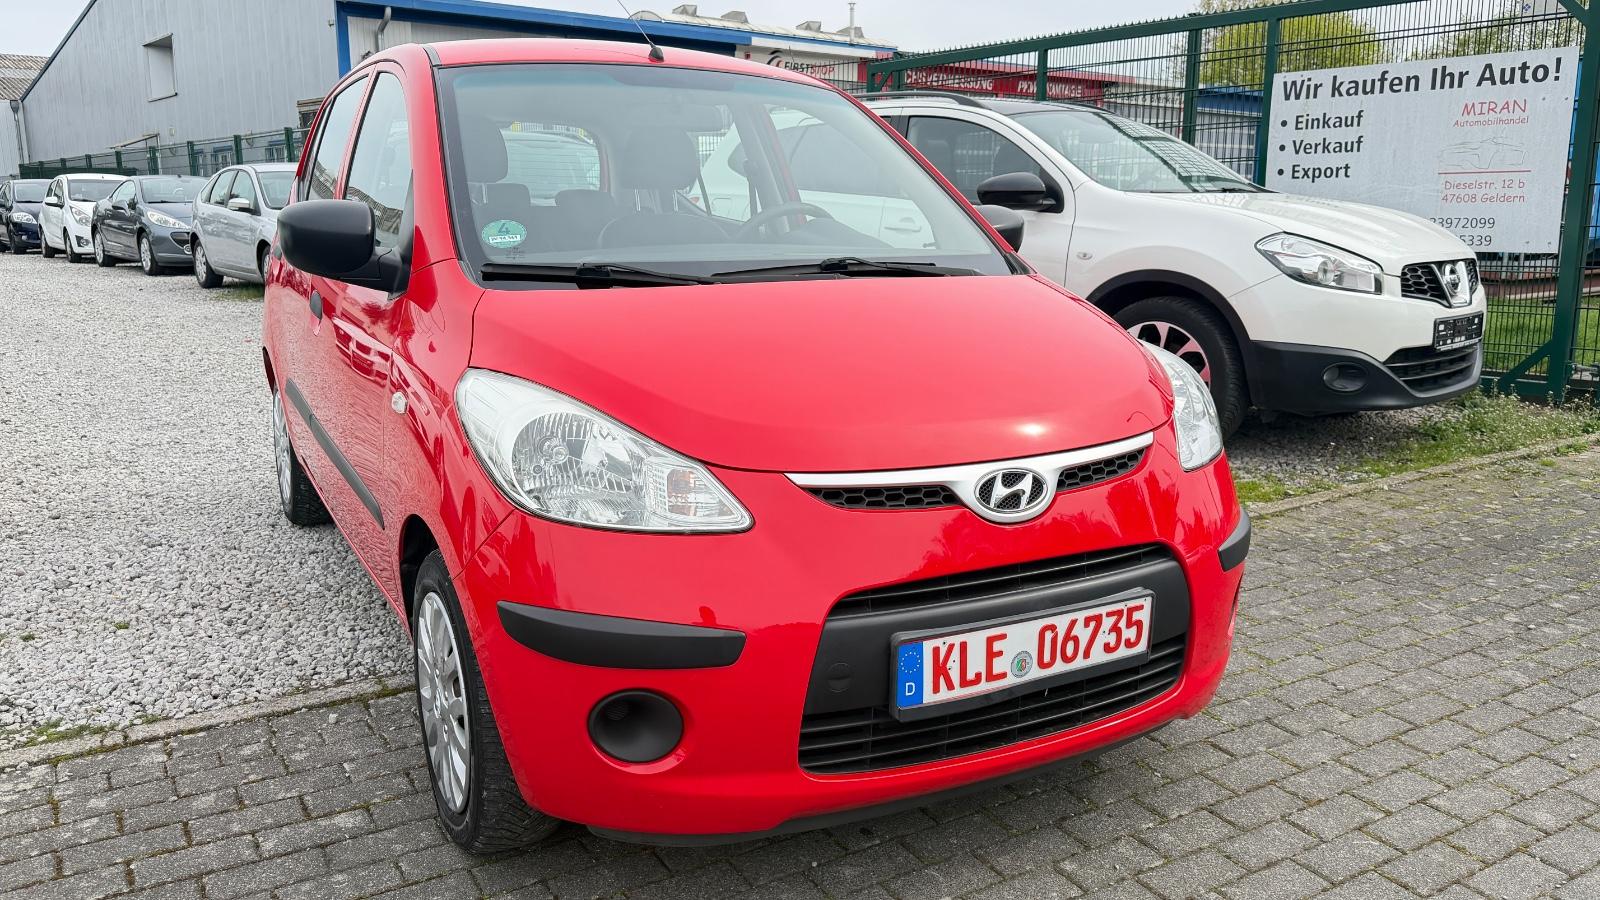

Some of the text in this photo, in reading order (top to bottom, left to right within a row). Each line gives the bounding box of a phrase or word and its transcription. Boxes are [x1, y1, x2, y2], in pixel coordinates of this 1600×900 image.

[1283, 57, 1562, 101] Wir kaufen Ihr Auto!
[1461, 98, 1527, 117] MIRAN
[1294, 110, 1364, 131] Einkauf
[1453, 116, 1529, 128] Automobilhandel
[1292, 136, 1364, 155] Verkauf
[1291, 163, 1351, 183] Export
[1444, 178, 1525, 191] Dieselstr. 12 b
[1441, 193, 1526, 204] 47608 Geldern
[498, 222, 511, 234] 4
[905, 682, 915, 696] D
[932, 633, 1007, 694] KLE
[1037, 604, 1145, 670] 06735
